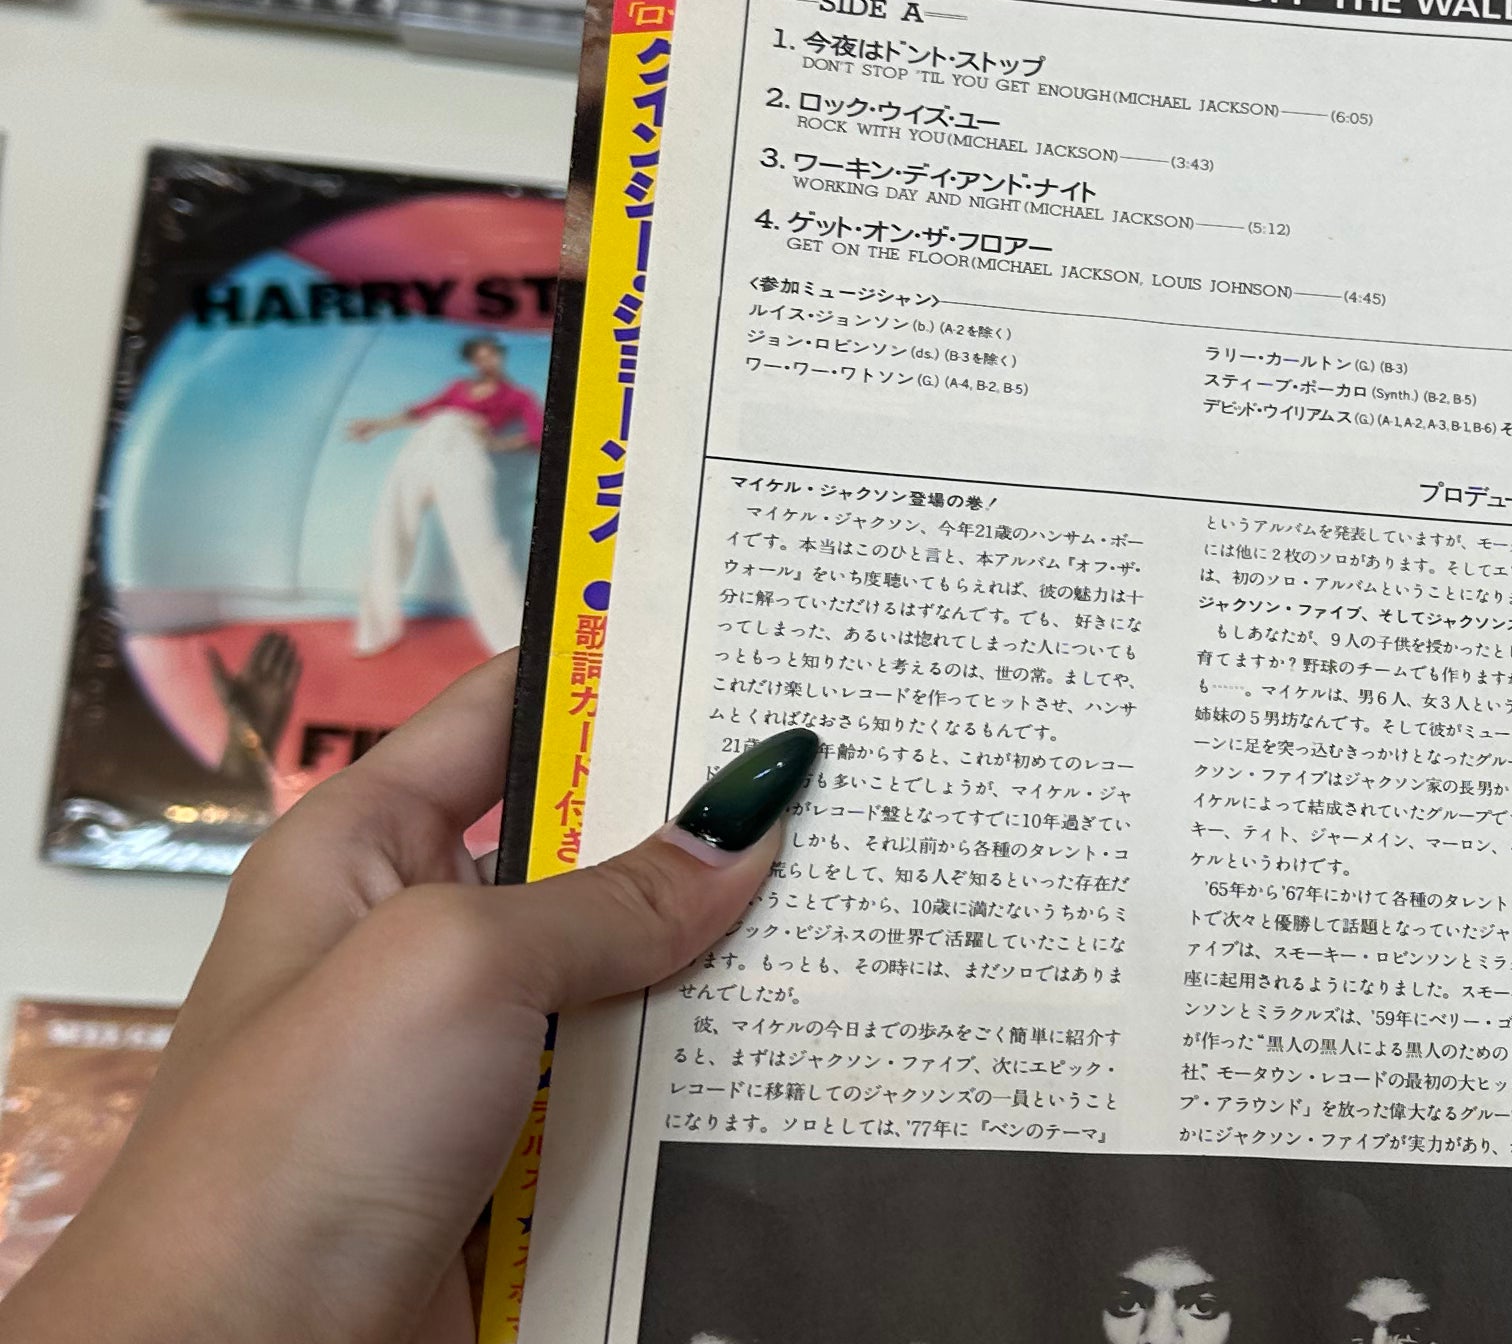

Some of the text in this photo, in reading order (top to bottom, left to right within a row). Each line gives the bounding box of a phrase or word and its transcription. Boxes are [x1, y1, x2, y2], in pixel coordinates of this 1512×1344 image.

[901, 2, 924, 23] A
[772, 28, 796, 51] 1.
[766, 87, 790, 109] 2.
[802, 56, 854, 75] DON'T
[862, 63, 909, 81] STOP
[953, 74, 989, 90] YOU
[996, 78, 1030, 95] GET
[1199, 99, 1279, 118] JACKSON)
[1331, 110, 1373, 127] (6:05)
[760, 147, 785, 170] 3.
[797, 115, 1215, 172] ROCK WITH JACKSON) (3:43)
[754, 213, 780, 232] 4.
[793, 175, 1291, 237] WORKING DAY AND JACKSON) (5:12)
[786, 237, 824, 253] GET
[832, 241, 860, 257] ON
[868, 245, 900, 261] THE
[1152, 274, 1202, 291] LOUIS
[1210, 279, 1293, 299] JOHNSON)
[1343, 289, 1386, 306] (4:45)
[199, 277, 452, 329] HARRY
